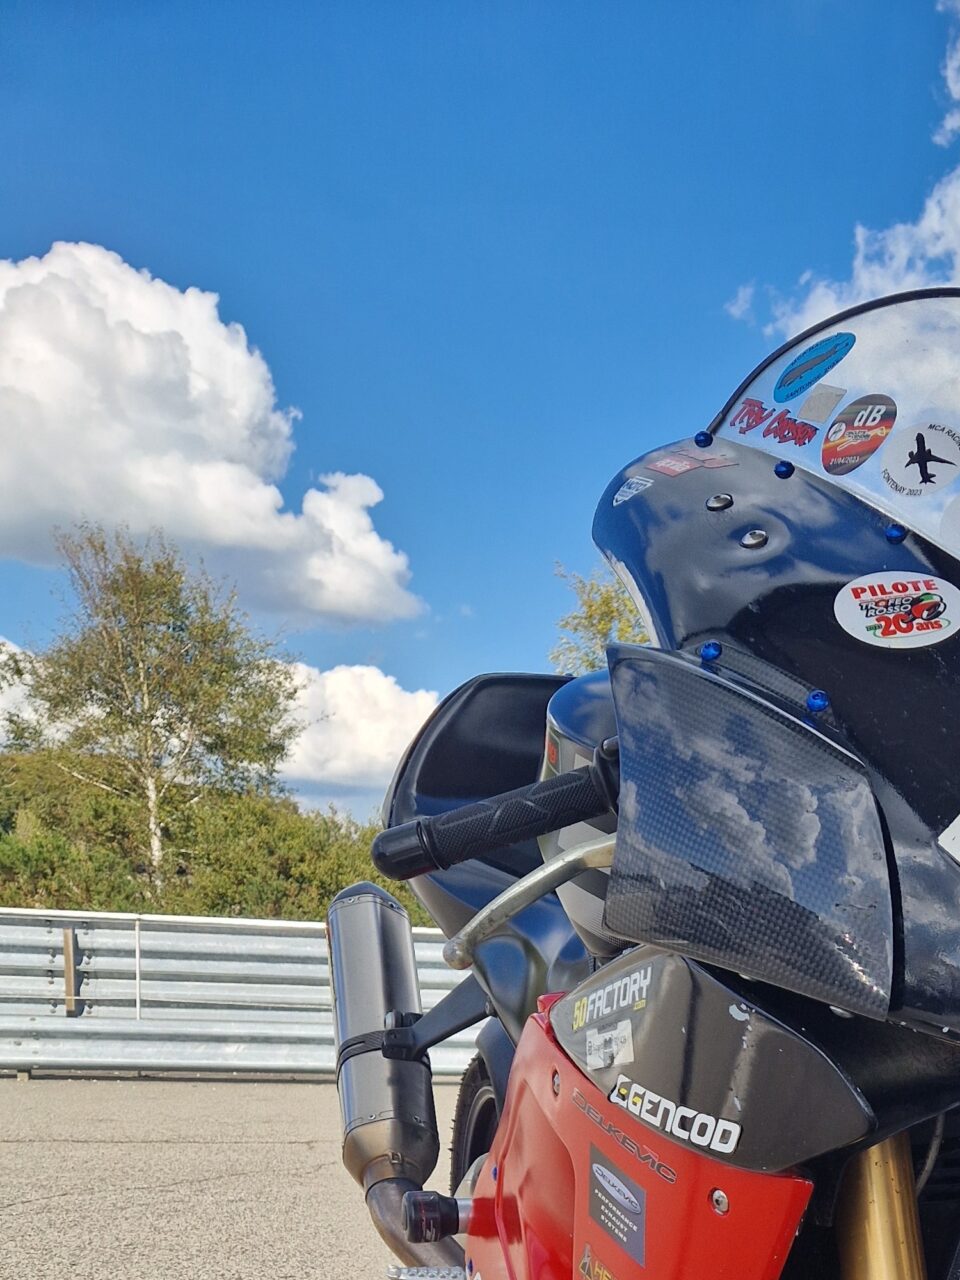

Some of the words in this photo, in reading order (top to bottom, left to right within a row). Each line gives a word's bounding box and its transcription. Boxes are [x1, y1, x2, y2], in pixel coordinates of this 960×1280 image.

[854, 405, 886, 427] dB
[928, 423, 945, 433] MCA
[882, 468, 906, 494] FONTENAY
[906, 488, 922, 496] 2023
[851, 579, 938, 600] PILOTE
[859, 596, 913, 611] TROFEO
[866, 605, 912, 618] ROSSO
[876, 614, 914, 637] 20
[915, 620, 942, 631] ans
[572, 966, 652, 1031] 50FACTORY
[572, 1088, 677, 1184] DELKEVIC
[595, 1168, 638, 1208] DELKEVIC
[594, 1189, 638, 1232] PERFORMANCE
[601, 1205, 629, 1231] EXHAUST
[601, 1214, 628, 1242] SYSTEMS
